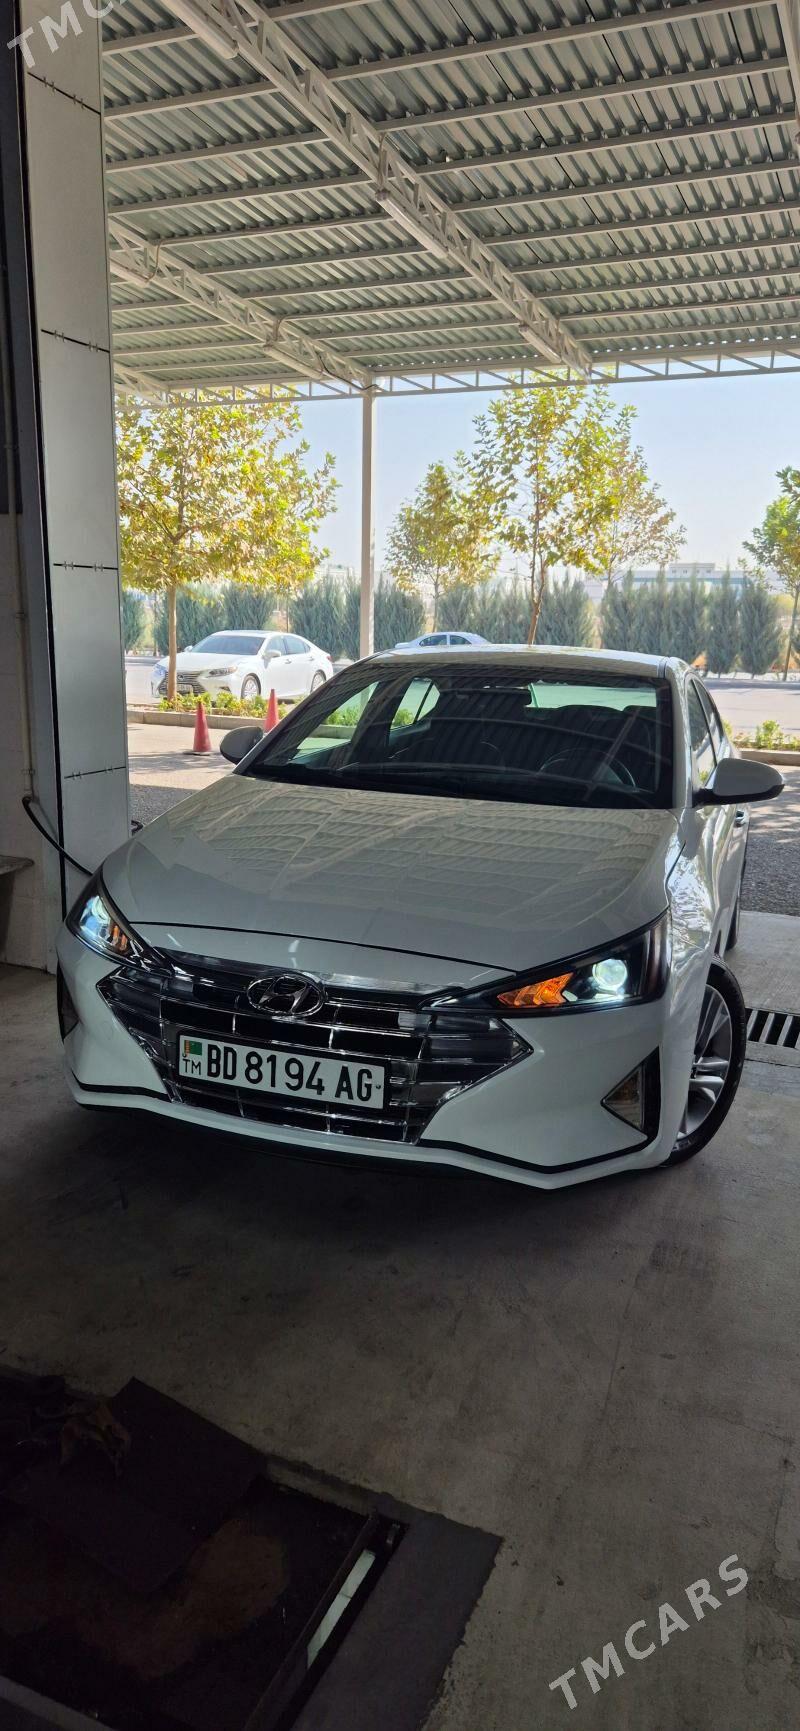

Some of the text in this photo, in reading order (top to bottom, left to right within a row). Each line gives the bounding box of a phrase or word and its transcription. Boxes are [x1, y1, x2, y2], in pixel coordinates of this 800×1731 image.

[182, 1058, 201, 1076] TM
[207, 1043, 373, 1102] BD 8194 AG
